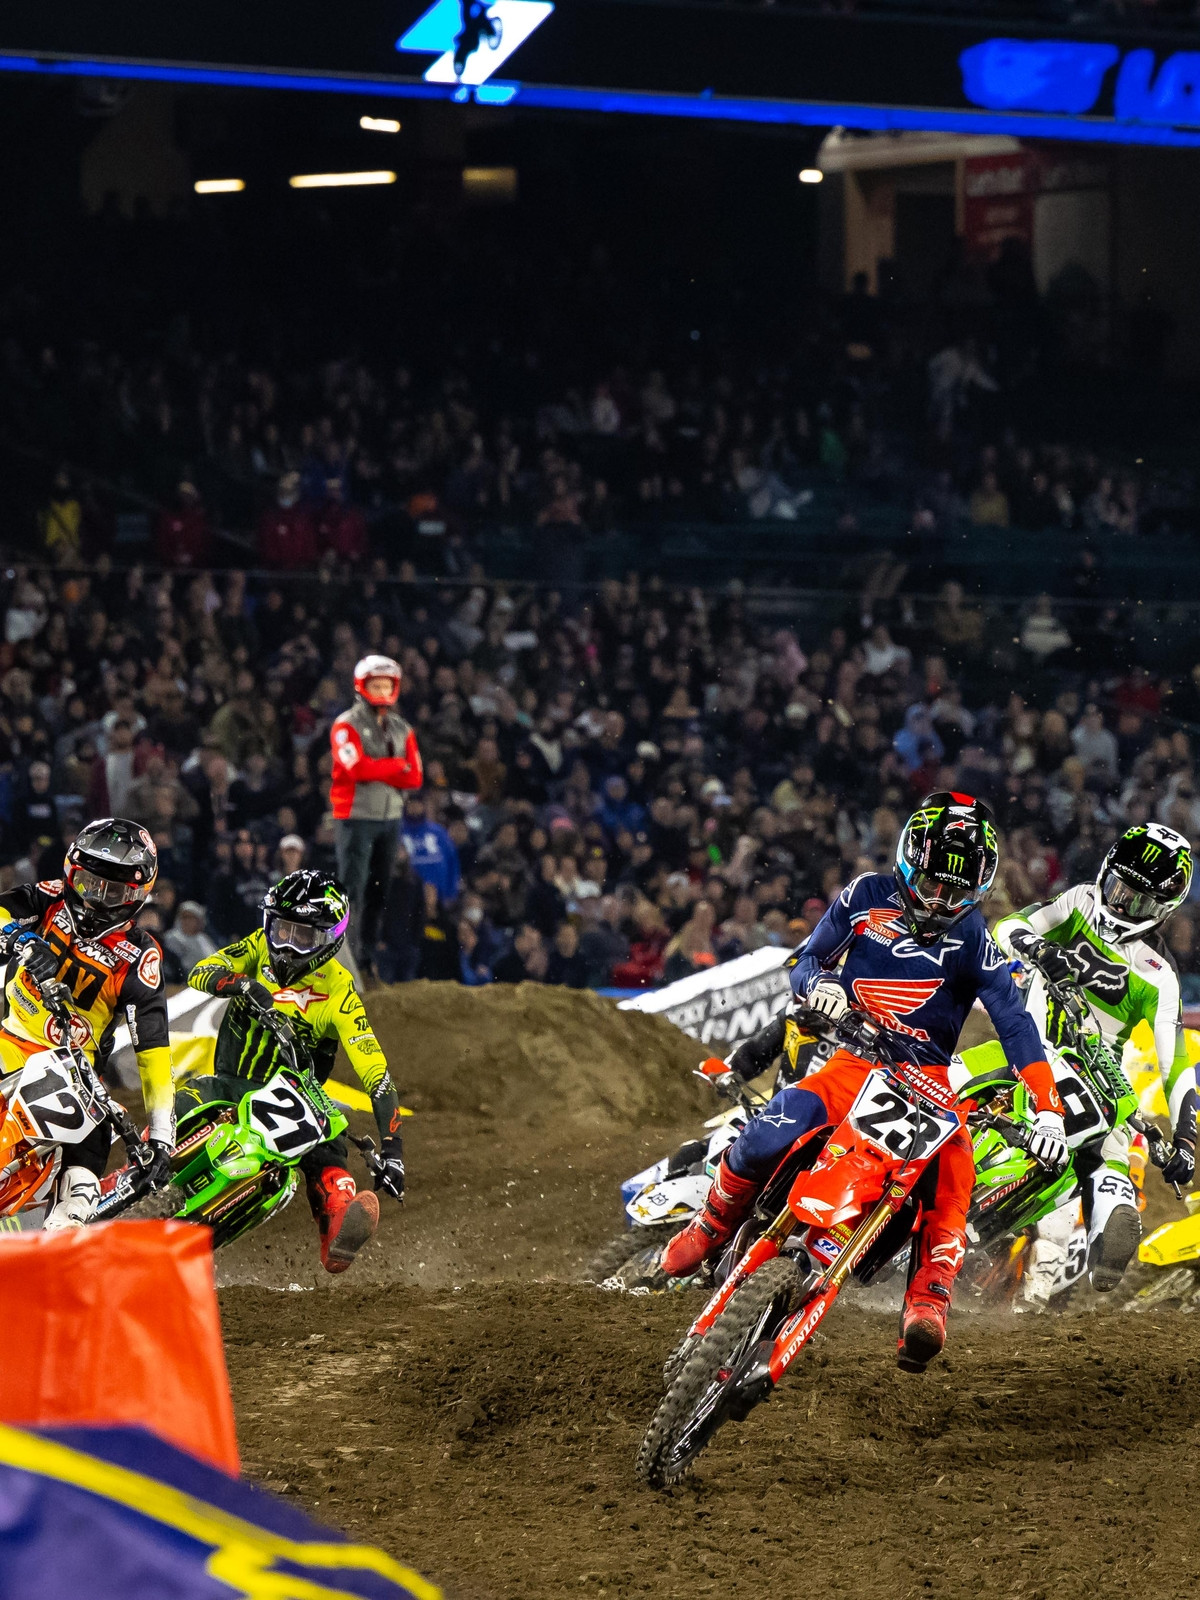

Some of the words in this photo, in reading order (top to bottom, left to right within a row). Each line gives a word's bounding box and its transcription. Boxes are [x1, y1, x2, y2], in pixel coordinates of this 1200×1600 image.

[935, 872, 971, 887] MONSTER
[86, 941, 121, 962] OUNTAIN
[863, 928, 893, 947] SHOWA
[373, 1069, 392, 1099] MONS
[902, 1072, 951, 1106] RENTHAL
[904, 1062, 955, 1099] RENTHAL
[1084, 1075, 1104, 1105] MONSTER
[20, 1065, 85, 1138] 12
[16, 1110, 31, 1131] KTM
[251, 1086, 322, 1154] 21
[855, 1091, 942, 1160] 23
[867, 1139, 891, 1157] HONDA
[796, 1200, 824, 1224] HONDA
[705, 1255, 752, 1316] DUNLOP
[781, 1301, 827, 1368] DUNLOP
